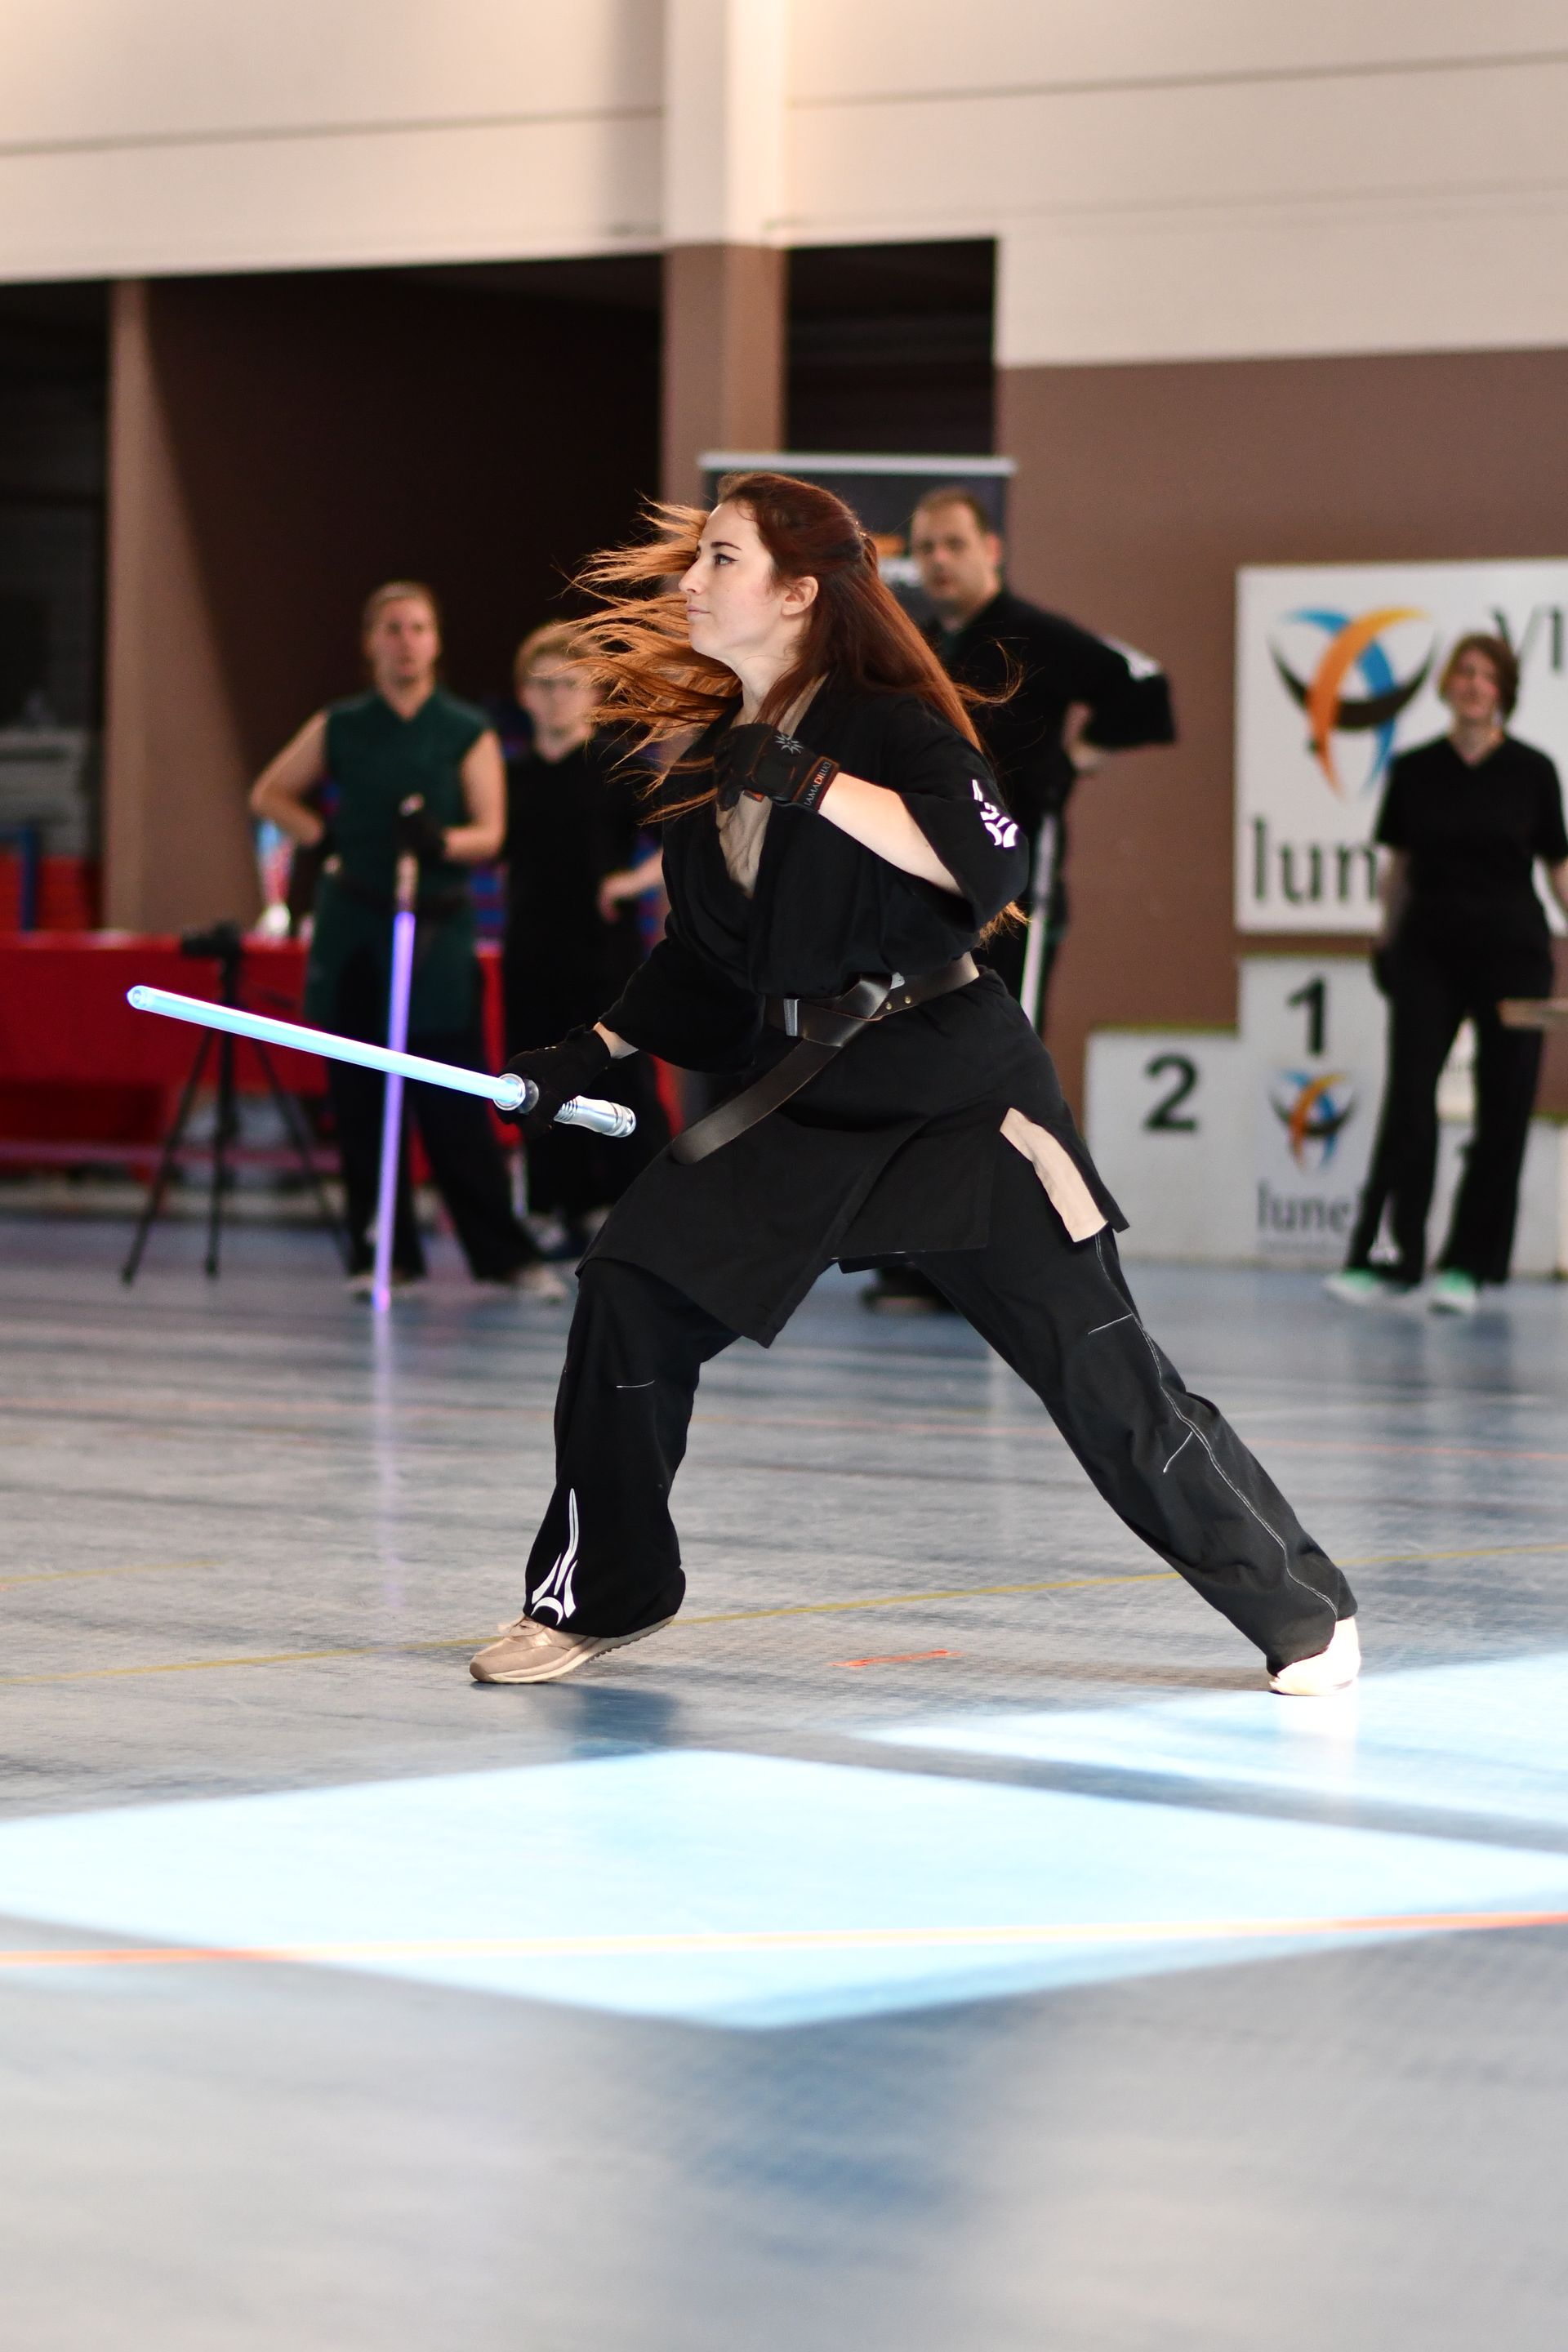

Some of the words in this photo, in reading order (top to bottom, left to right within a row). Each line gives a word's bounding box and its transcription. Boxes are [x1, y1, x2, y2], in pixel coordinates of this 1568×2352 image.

[1250, 814, 1380, 902] lun
[1285, 974, 1327, 1057] 1
[1145, 1051, 1198, 1134] 2
[1256, 1178, 1352, 1232] lune
